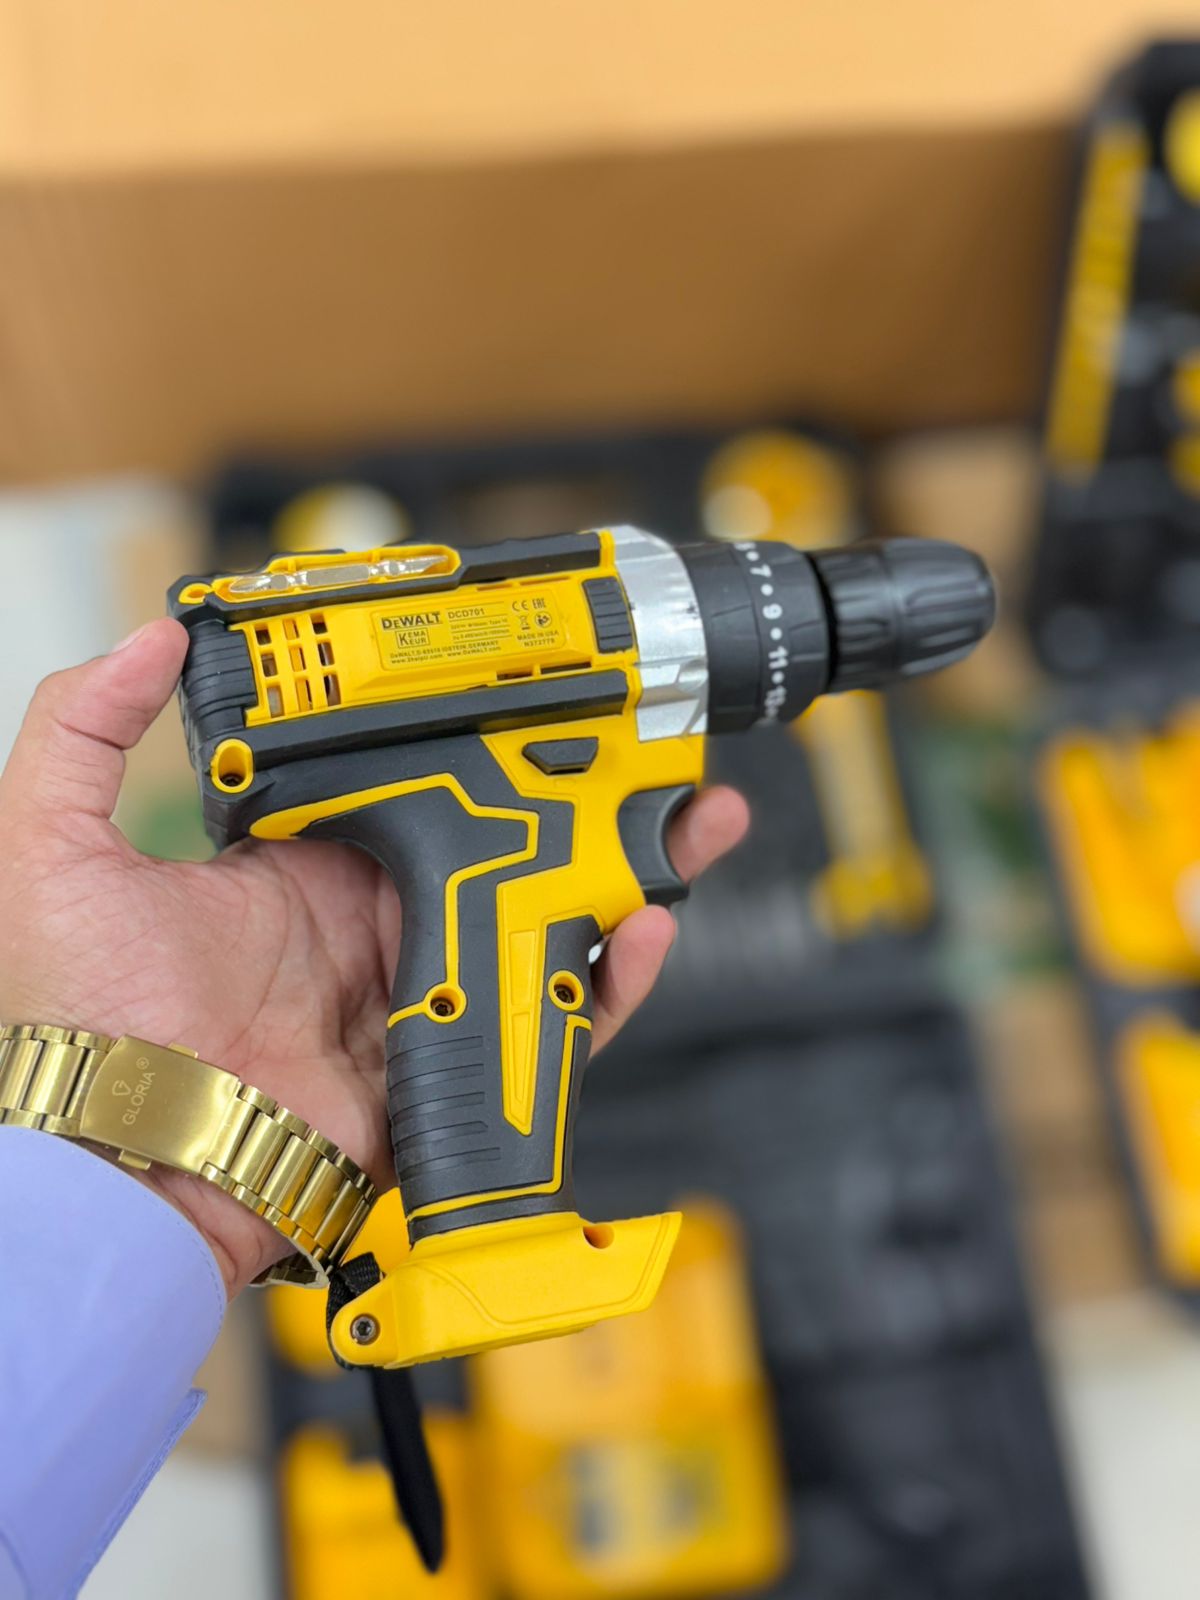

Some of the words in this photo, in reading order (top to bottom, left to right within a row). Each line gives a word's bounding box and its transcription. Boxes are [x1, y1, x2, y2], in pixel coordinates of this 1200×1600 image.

[749, 563, 772, 578] 7
[447, 607, 485, 619] DCD701
[762, 603, 783, 620] 9
[768, 645, 788, 669] 11
[122, 1072, 156, 1125] GLORIA
